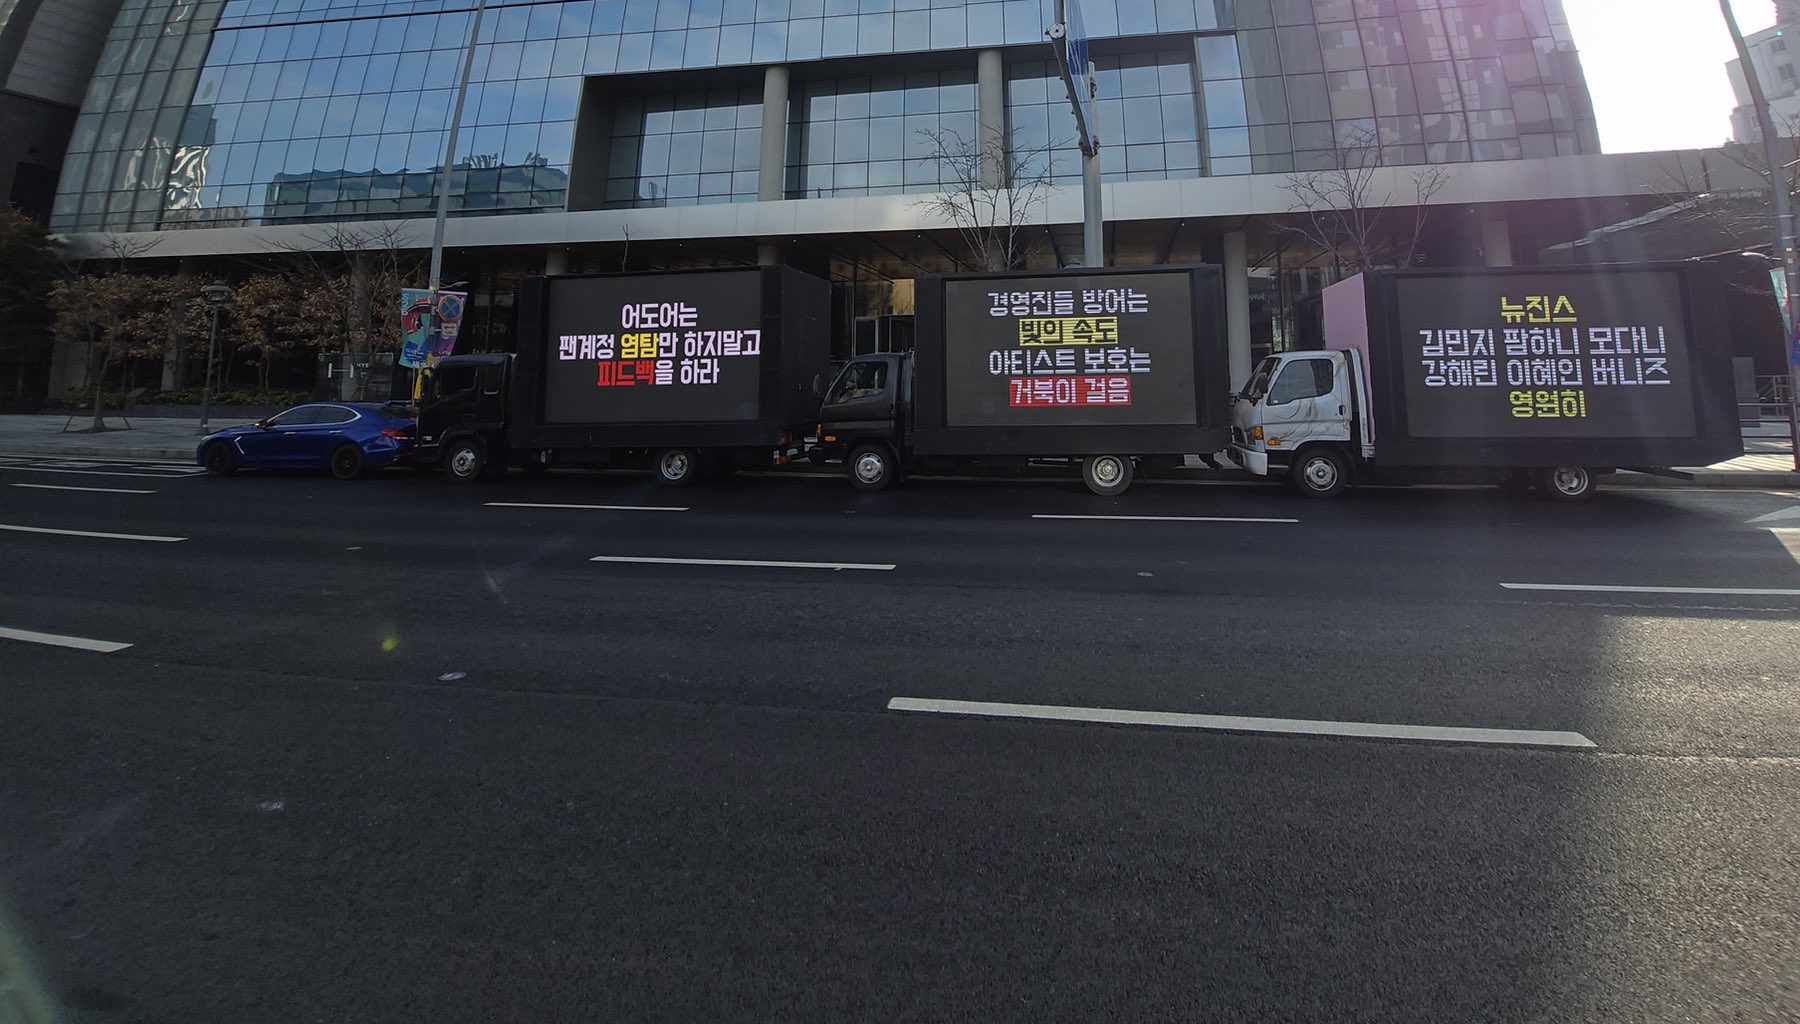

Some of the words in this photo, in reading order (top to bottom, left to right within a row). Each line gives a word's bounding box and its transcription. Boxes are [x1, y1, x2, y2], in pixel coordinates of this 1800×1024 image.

[621, 301, 698, 329] 어도어는
[988, 290, 1075, 317] 경영진들
[1082, 288, 1149, 314] 방어는
[1500, 295, 1578, 323] 뉴진스
[559, 334, 615, 361] 팬계정
[620, 332, 679, 359] 염탐만
[684, 329, 761, 357] 하지말고
[1021, 319, 1063, 345] 빛의
[1072, 318, 1117, 343] 속도
[1419, 328, 1496, 357] 김민지
[1502, 327, 1580, 356] 팜하니
[1588, 326, 1667, 355] 모다니
[597, 360, 674, 387] 피드백을
[680, 358, 720, 385] 하라
[989, 348, 1077, 376] 아티스트
[1084, 347, 1152, 374] 보호는
[1421, 358, 1498, 387] 강해린
[1506, 358, 1583, 386] 이혜인
[1591, 357, 1671, 386] 버니즈
[1011, 378, 1076, 404] 거북이
[1084, 377, 1130, 403] 걸음
[1509, 389, 1587, 418] 영원히
